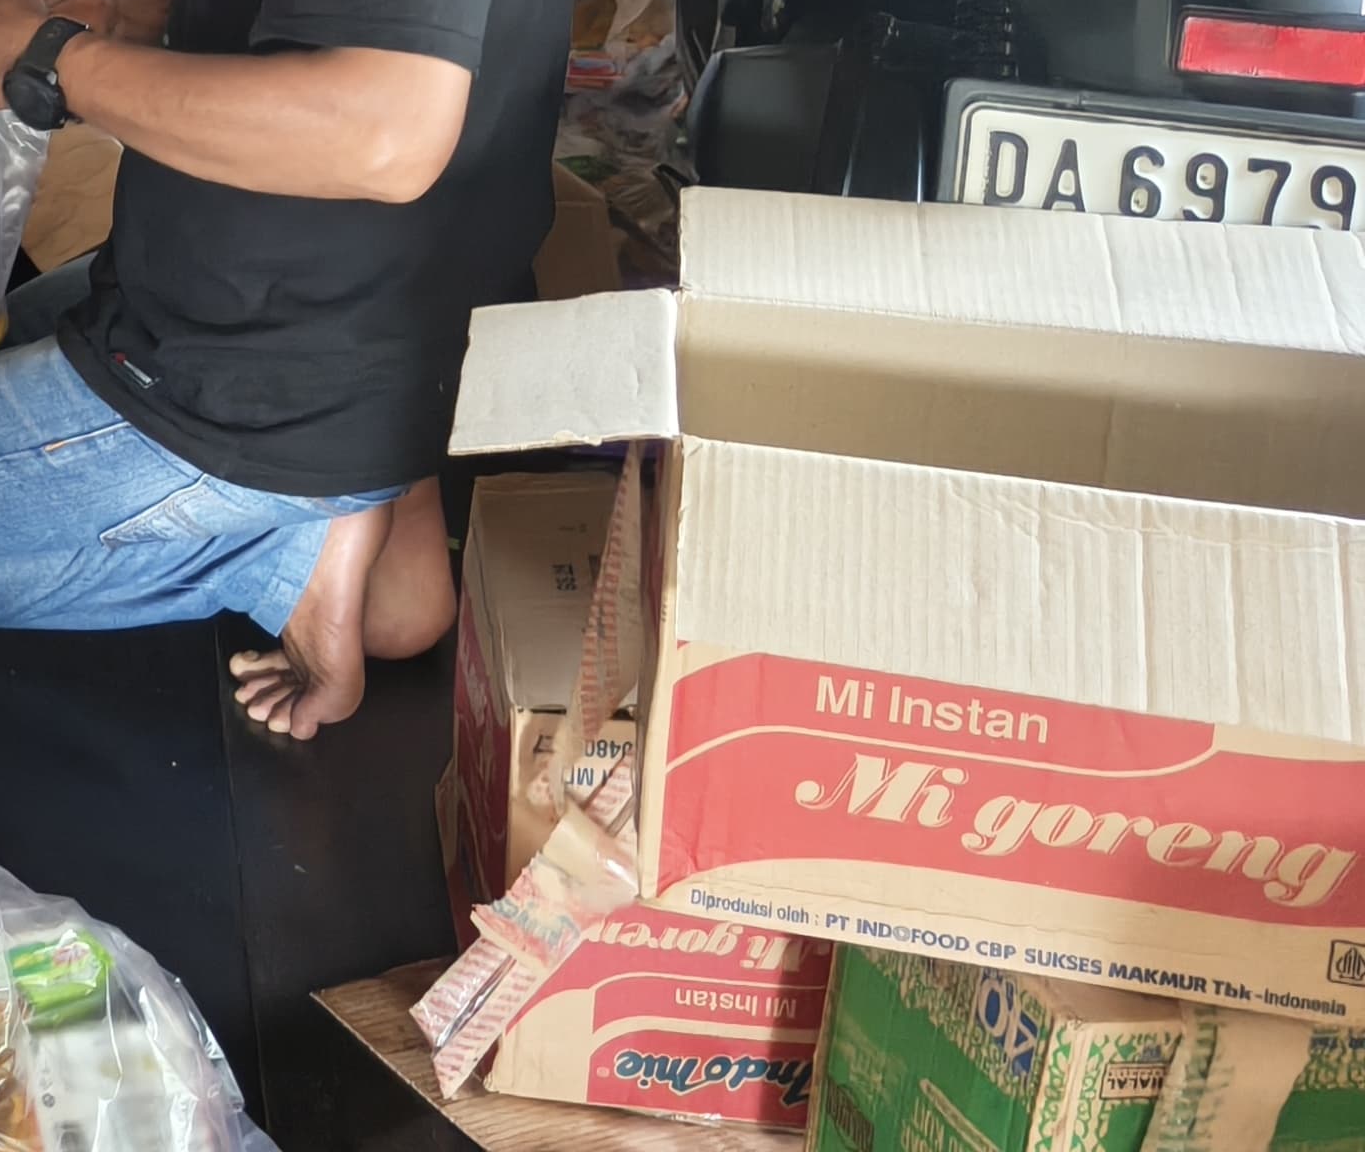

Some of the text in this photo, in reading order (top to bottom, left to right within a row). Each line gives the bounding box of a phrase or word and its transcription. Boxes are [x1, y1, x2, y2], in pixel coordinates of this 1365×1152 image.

[983, 131, 1358, 232] DA 6979
[815, 675, 1050, 744] Mi Instan
[794, 752, 1359, 908] Mi goreng
[580, 920, 744, 951] goren
[690, 888, 773, 918] Diproduksi
[776, 904, 810, 925] oleh
[825, 913, 851, 931] PT
[856, 918, 970, 952] INDOFOOD
[975, 940, 1018, 960] CBP
[1023, 947, 1103, 976] SUKSES
[1107, 962, 1208, 994] MAKMUR
[675, 986, 758, 1017] Instan
